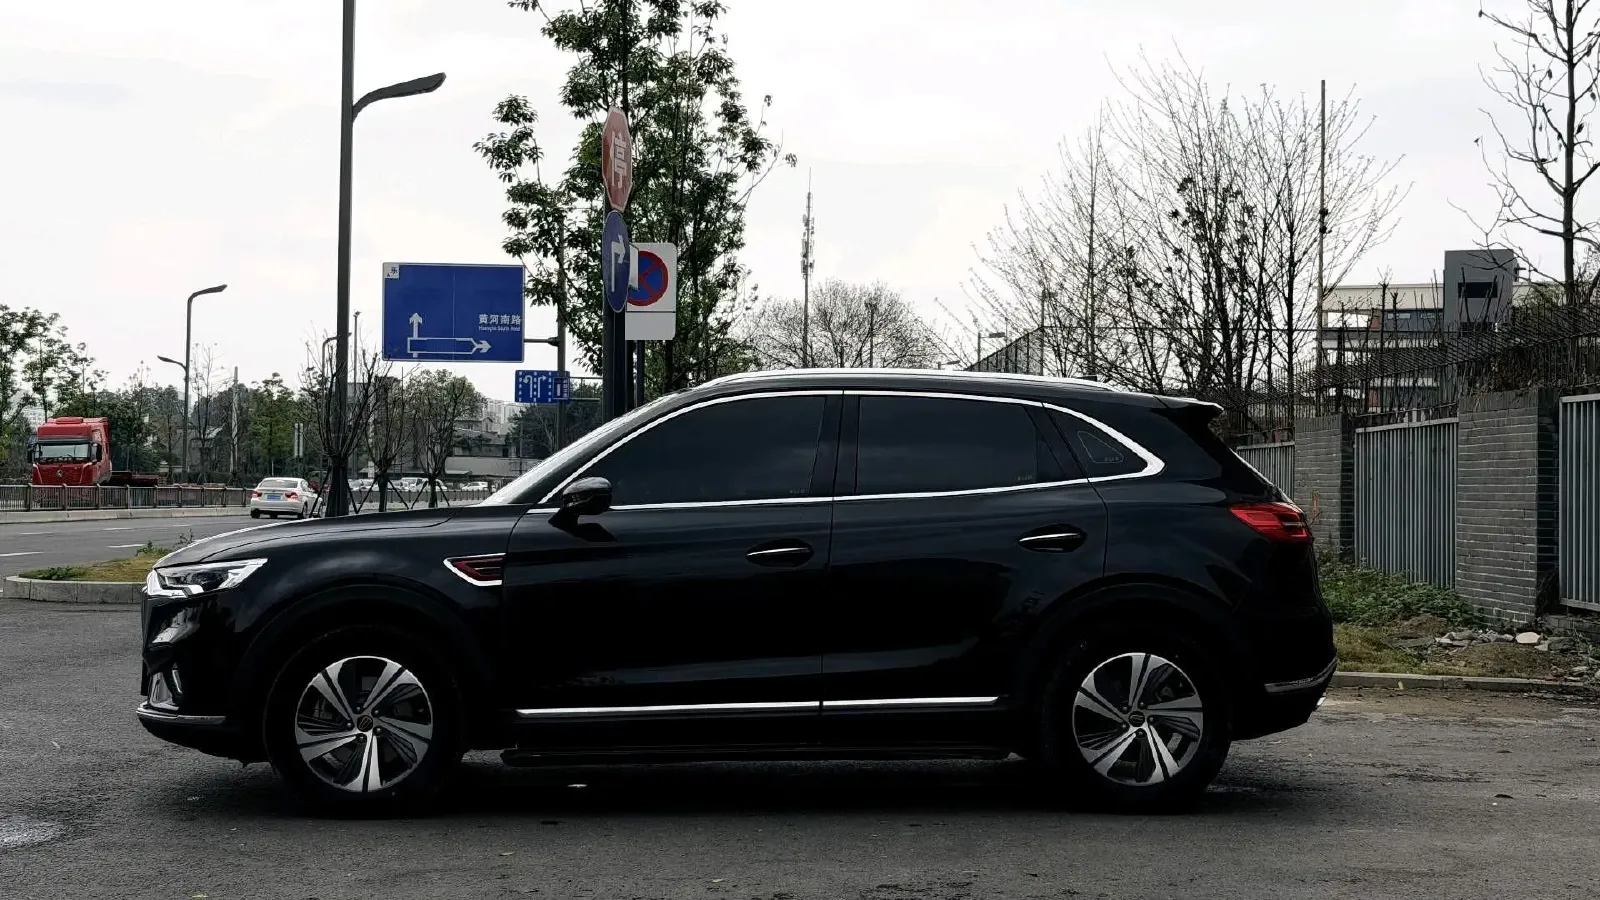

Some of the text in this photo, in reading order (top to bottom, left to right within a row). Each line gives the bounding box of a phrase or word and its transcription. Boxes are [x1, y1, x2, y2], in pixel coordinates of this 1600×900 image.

[609, 131, 627, 188] 停
[479, 314, 521, 325] 黄河南路
